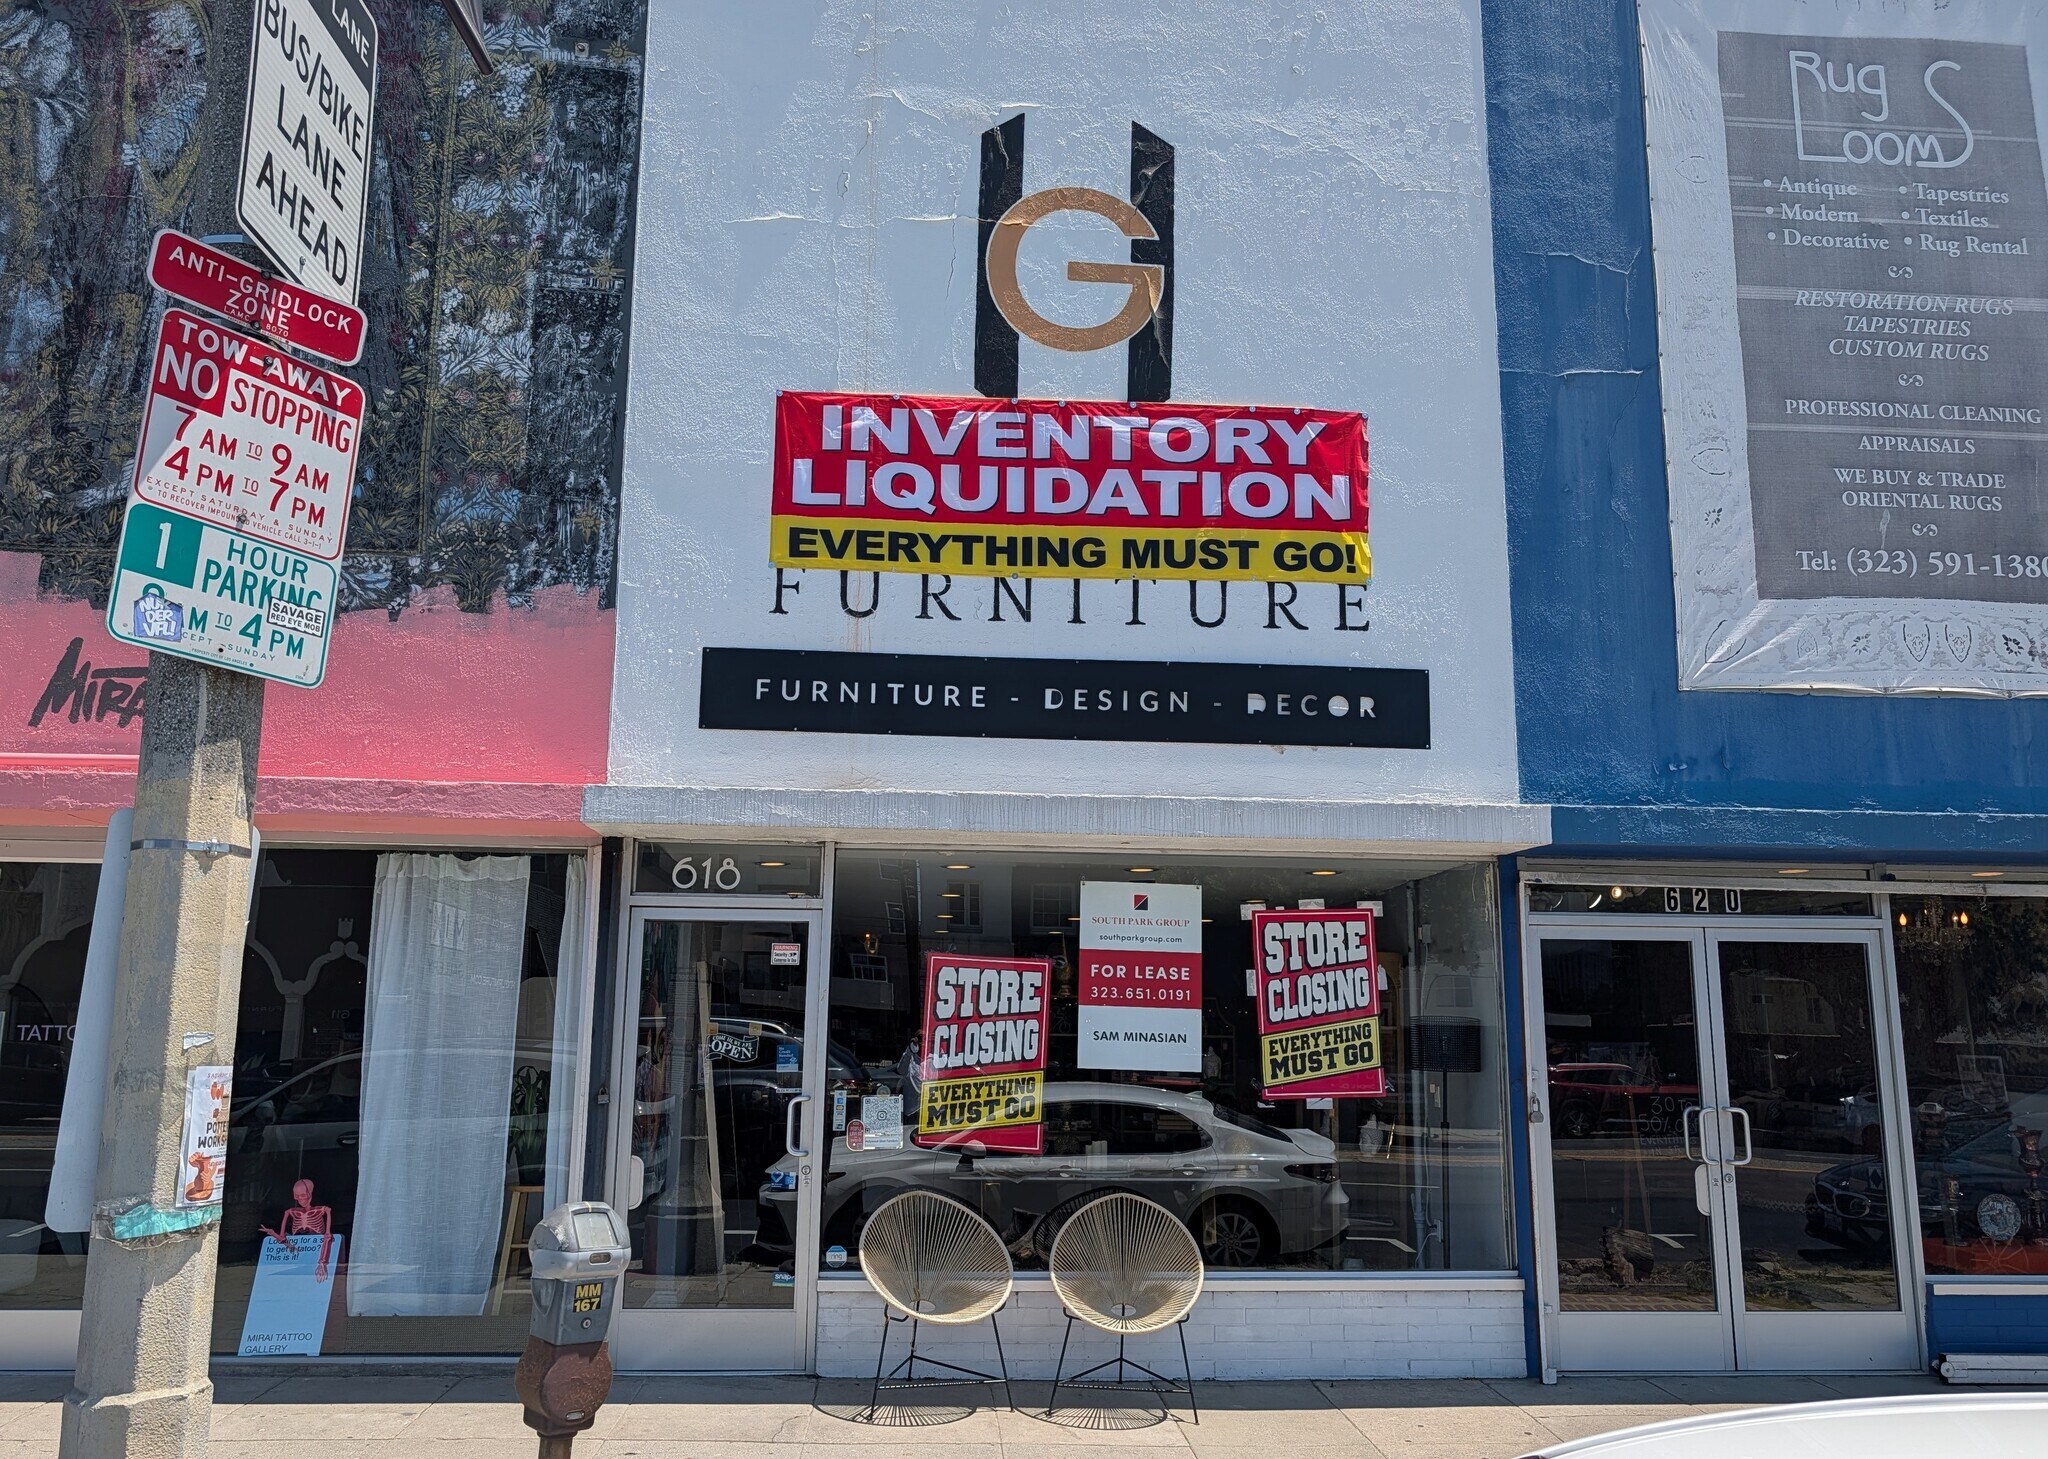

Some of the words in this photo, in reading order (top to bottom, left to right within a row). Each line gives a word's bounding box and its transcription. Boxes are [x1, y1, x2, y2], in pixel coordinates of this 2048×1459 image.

[332, 0, 370, 68] LANE
[264, 0, 364, 162] BUS/BIKE
[1789, 50, 1889, 122] Rug
[277, 83, 346, 212] LANE
[1778, 176, 1858, 199] Antique
[1912, 183, 2010, 205] Tapestries
[256, 150, 347, 286] AHEAD
[1780, 203, 1859, 223] Modern
[1915, 208, 1989, 229] Textiles
[1782, 228, 1890, 250] Decorative
[1919, 233, 1960, 257] Rug
[1965, 236, 2030, 256] Rental
[168, 246, 353, 334] ANTI-GRIDLOCK
[1794, 290, 1951, 312] RESTORATION
[1953, 297, 2013, 315] RUGS
[226, 289, 291, 330] ZONE
[1843, 315, 1971, 337] TAPESTRIES
[178, 318, 352, 407] TOW-AWAY
[1828, 338, 1925, 359] CUSTOM
[1929, 342, 1990, 361] RUGS
[158, 344, 220, 400] NO
[230, 378, 351, 453] STOPPING
[1785, 398, 1935, 420] PROFESSIONAL
[1938, 404, 2042, 424] CLEANING
[821, 404, 1328, 466] INVENTORY
[1858, 436, 1976, 454] APPRAISALS
[175, 405, 198, 442] 7
[199, 428, 238, 460] AM
[247, 441, 263, 458] TO
[271, 443, 292, 477] 9
[294, 463, 330, 494] AM
[164, 446, 190, 480] 4
[196, 463, 234, 497] PM
[244, 477, 259, 493] TO
[268, 477, 290, 512] 7
[290, 497, 326, 528] PM
[791, 458, 1352, 521] LIQUIDATION
[1833, 468, 1867, 484] WE
[1871, 469, 1915, 486] BUY
[1917, 472, 1934, 487] &
[1937, 472, 2006, 489] TRADE
[146, 476, 195, 497] EXCEPT
[200, 494, 267, 521] SATURDAY
[273, 518, 280, 527] &
[287, 523, 333, 544] SUNDAY
[1842, 491, 1946, 509] ORIENTAL
[1949, 494, 2003, 511] RUGS
[157, 489, 167, 499] TO
[169, 493, 205, 511] RECOVER
[252, 521, 282, 537] VEHICLE
[284, 531, 301, 543] CALL
[303, 538, 321, 549] 3-1-1
[156, 522, 172, 570] 1
[226, 538, 309, 584] HOUR
[788, 527, 1107, 566] EVERYTHING
[1122, 538, 1259, 570] MUST
[1273, 541, 1358, 574] GO!
[1796, 550, 1837, 571] Tel:
[1847, 548, 1918, 578] (323)
[1928, 551, 2048, 579] 591-1380
[272, 602, 322, 625] SAVAGE
[769, 568, 1371, 631] FURNITURE
[181, 606, 209, 634] M
[216, 612, 232, 627] TO
[239, 613, 262, 647] 4
[269, 629, 304, 659] PM
[271, 612, 286, 623] RED
[288, 618, 302, 628] EYE
[304, 621, 321, 632] MOB
[182, 631, 213, 645] CEPT
[228, 643, 276, 662] SUNDAY
[755, 678, 986, 709] FURNITURE
[1044, 687, 1189, 713] DESIGN
[1247, 692, 1376, 718] DECOR
[671, 856, 741, 890] 618
[1666, 887, 1739, 912] 620
[1091, 916, 1126, 926] SOUTH
[1128, 918, 1153, 926] PARK
[1155, 919, 1190, 927] GROUP
[1099, 934, 1182, 944] southparkgroup.com
[1263, 921, 1367, 974] STORE
[1090, 964, 1127, 978] FOR
[1135, 966, 1190, 981] LEASE
[935, 966, 1042, 1019] STORE
[1090, 986, 1191, 1001] 323.651.0191
[1267, 966, 1370, 1023] CLOSING
[710, 1040, 752, 1059] OPEN
[931, 1019, 1040, 1070] CLOSING
[1093, 1030, 1120, 1041] SAM
[1123, 1032, 1187, 1044] MINASIAN
[1268, 1023, 1372, 1056] EVERYTHING
[1269, 1047, 1341, 1080] MUST
[1343, 1041, 1375, 1066] GO
[928, 1076, 1036, 1106] EVERYTHING
[1650, 1096, 1675, 1114] 30
[926, 1099, 1000, 1129] MUST
[1004, 1094, 1036, 1121] GO
[206, 1121, 229, 1134] POTTE
[198, 1135, 227, 1149] WORKS
[268, 1237, 299, 1246] Loing
[831, 1253, 842, 1261] ring
[576, 1283, 602, 1298] MM
[574, 1298, 600, 1313] 167
[244, 1344, 288, 1354] GALLERY
[247, 1333, 273, 1342] MIRAI
[276, 1332, 313, 1342] TATTOO
